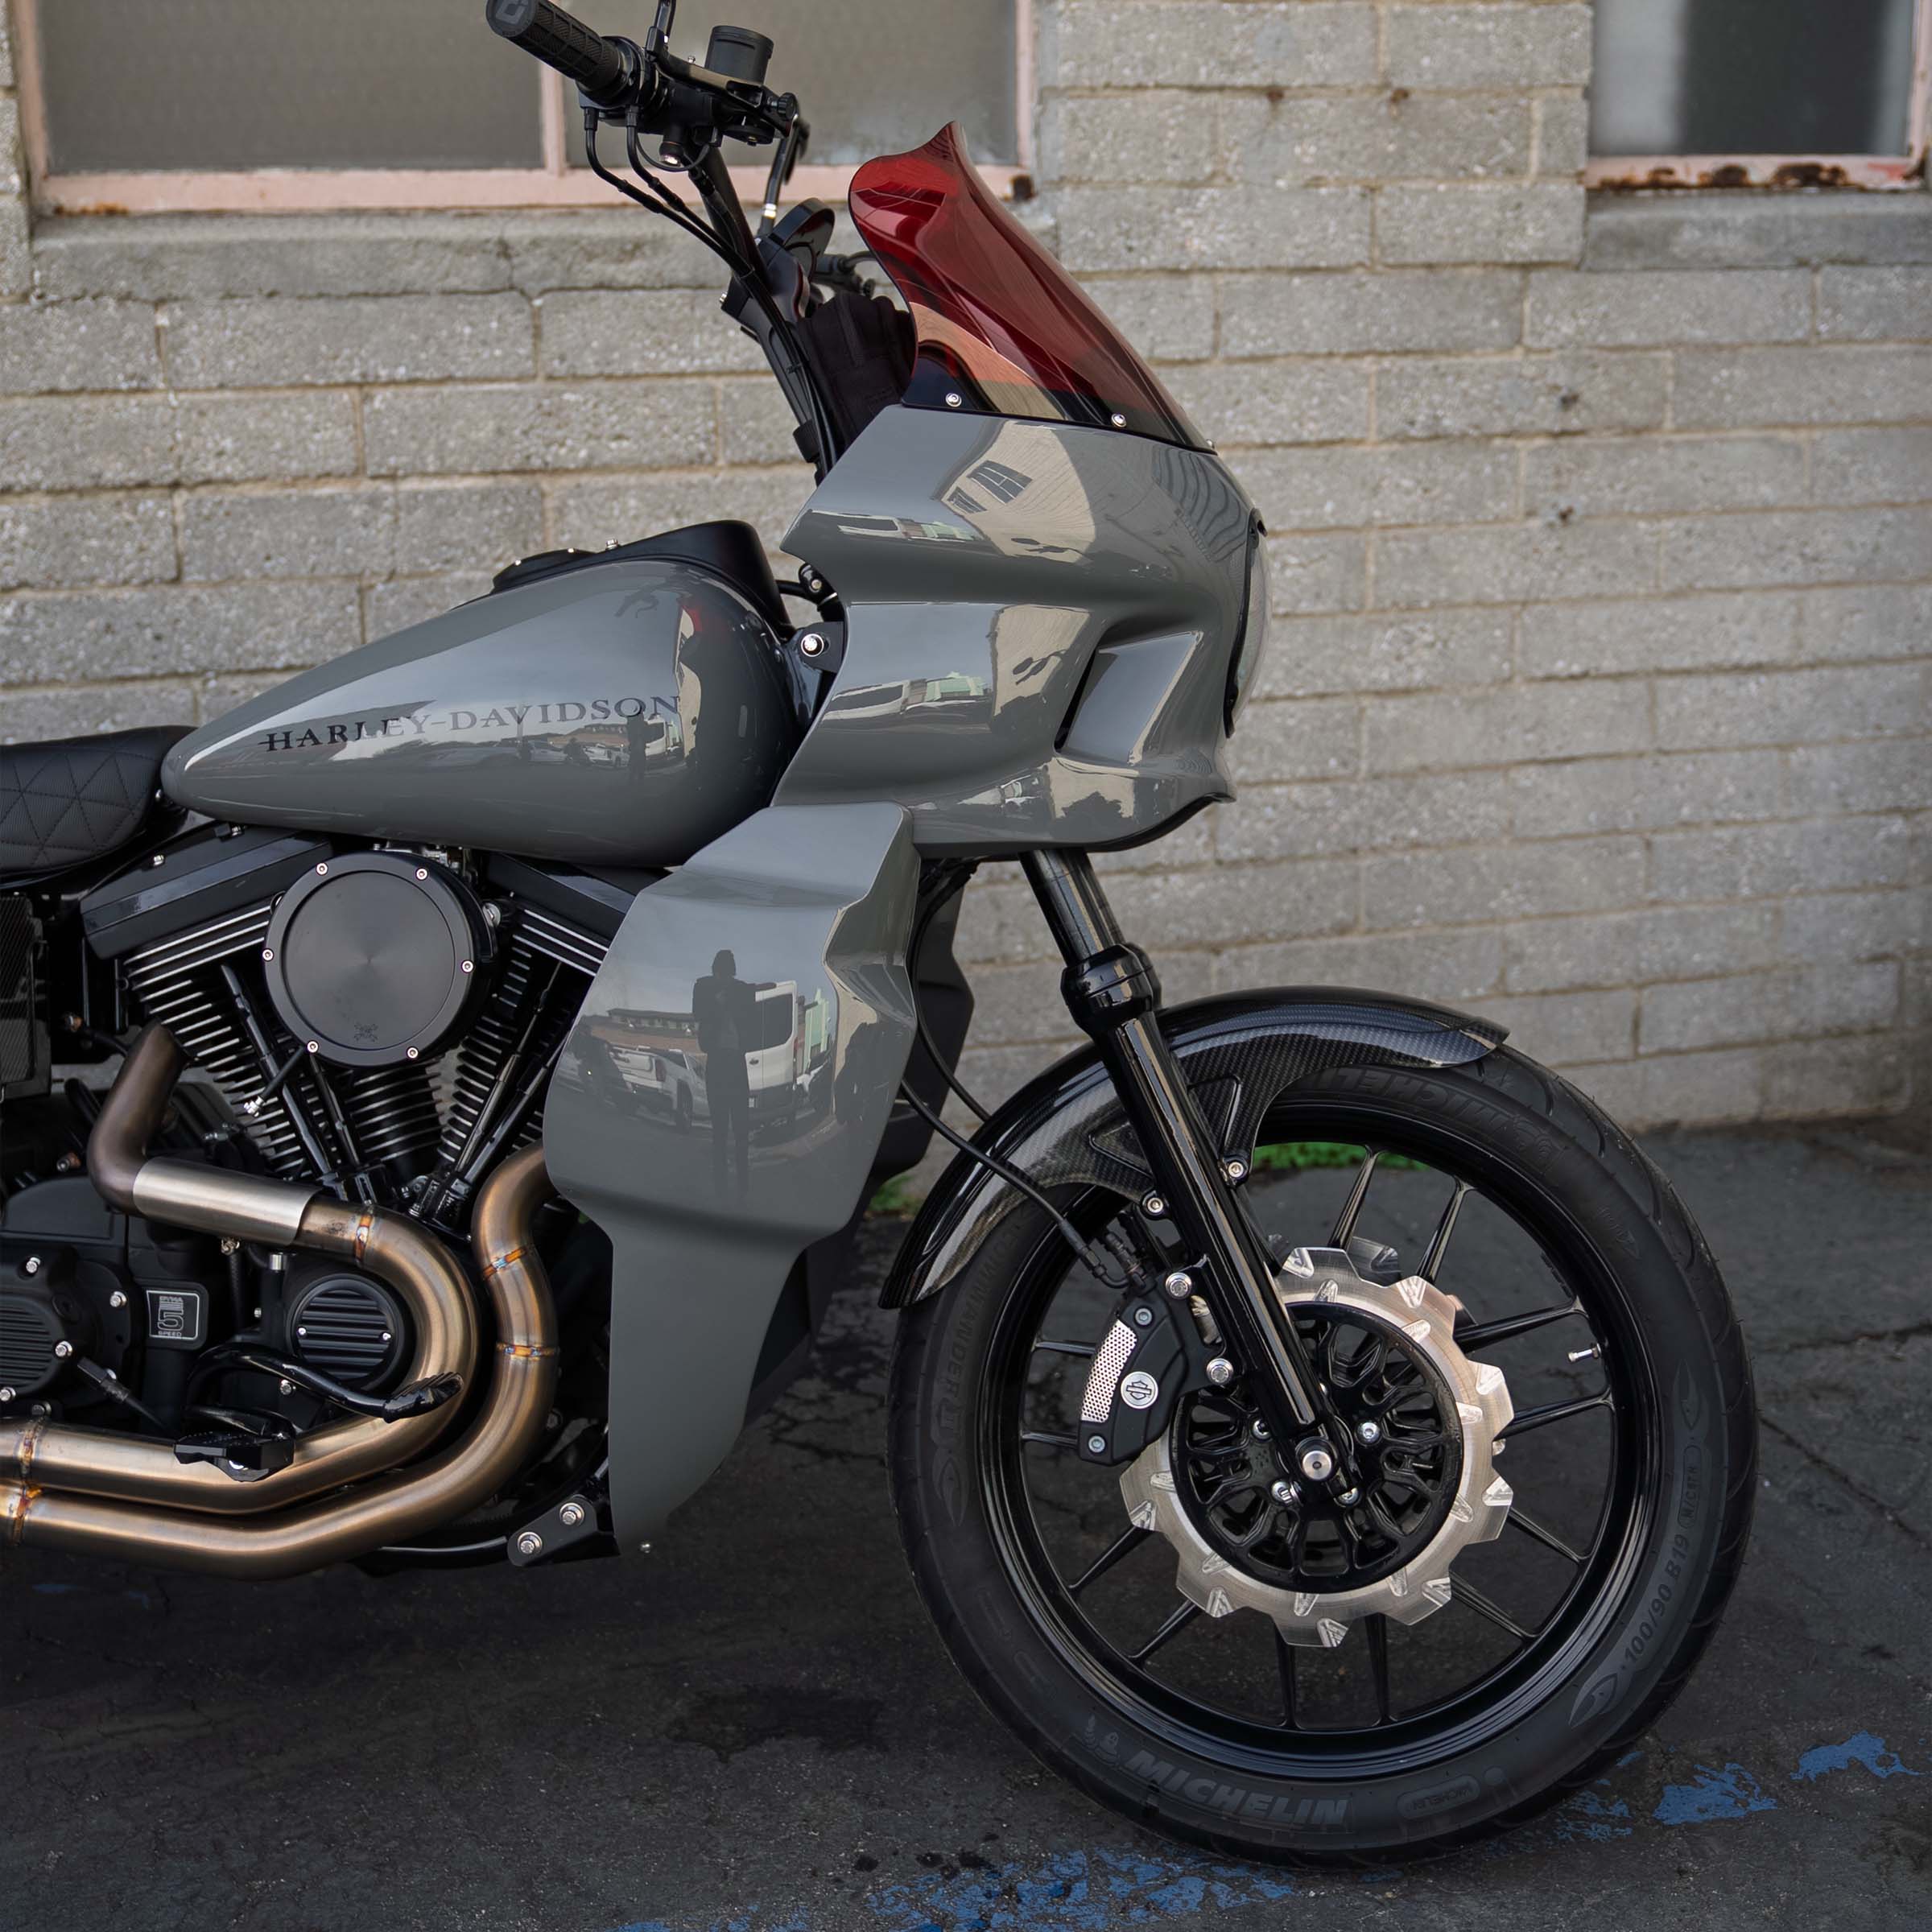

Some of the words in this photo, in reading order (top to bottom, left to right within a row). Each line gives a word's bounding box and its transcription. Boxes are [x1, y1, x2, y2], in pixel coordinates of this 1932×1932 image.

[258, 696, 680, 752] HARLEY-DAVIDSON
[158, 1302, 184, 1331] 5
[1624, 1583, 1673, 1663] 100/90
[1124, 1749, 1349, 1827] MICHELIN
